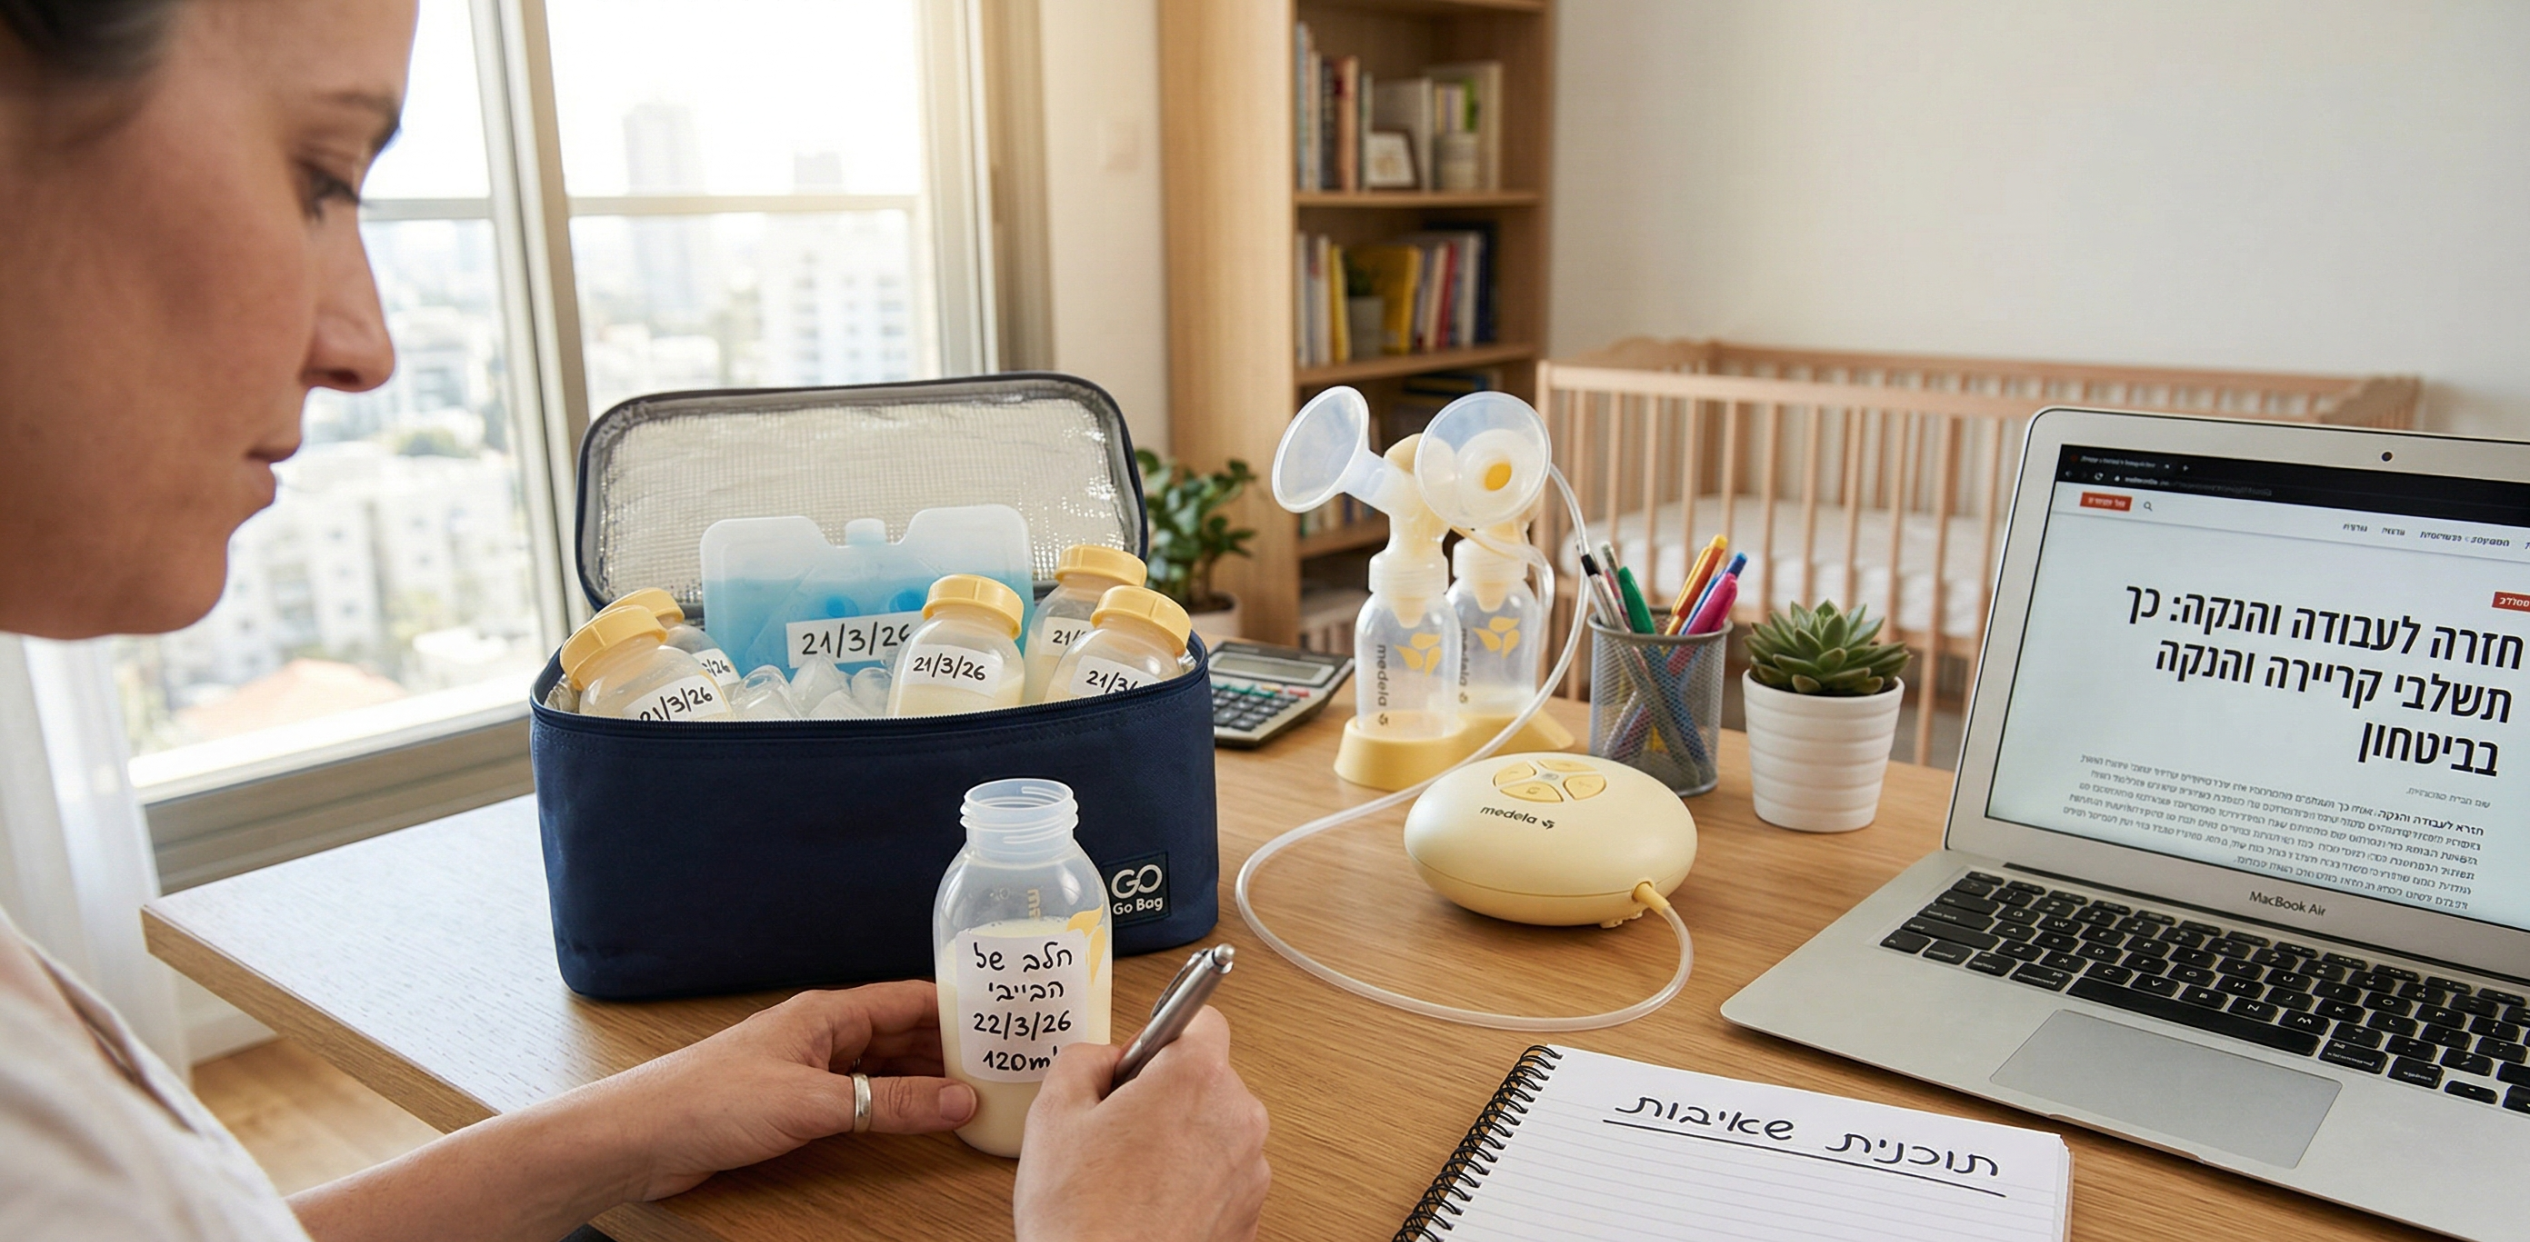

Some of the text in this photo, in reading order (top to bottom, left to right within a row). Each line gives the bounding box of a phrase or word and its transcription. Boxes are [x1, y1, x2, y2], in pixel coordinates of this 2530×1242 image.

[2126, 585, 2525, 671] חזרה לעבודה והנקה: כך
[913, 653, 986, 682] 21/3/26
[1377, 644, 1389, 707] medela
[2155, 639, 2513, 724] תשלבי קריירה והנקה
[2357, 721, 2500, 778] בביטחון
[1480, 806, 1538, 826] medela
[1111, 863, 1164, 899] GO
[1113, 897, 1164, 916] Go Bag
[2248, 891, 2327, 917] MacBook Air
[974, 941, 1074, 973] חלב של
[988, 980, 1065, 1003] הבייבי
[973, 1010, 1072, 1041] 22/3/26
[1614, 1094, 2000, 1178] תוכנית שאיבות
